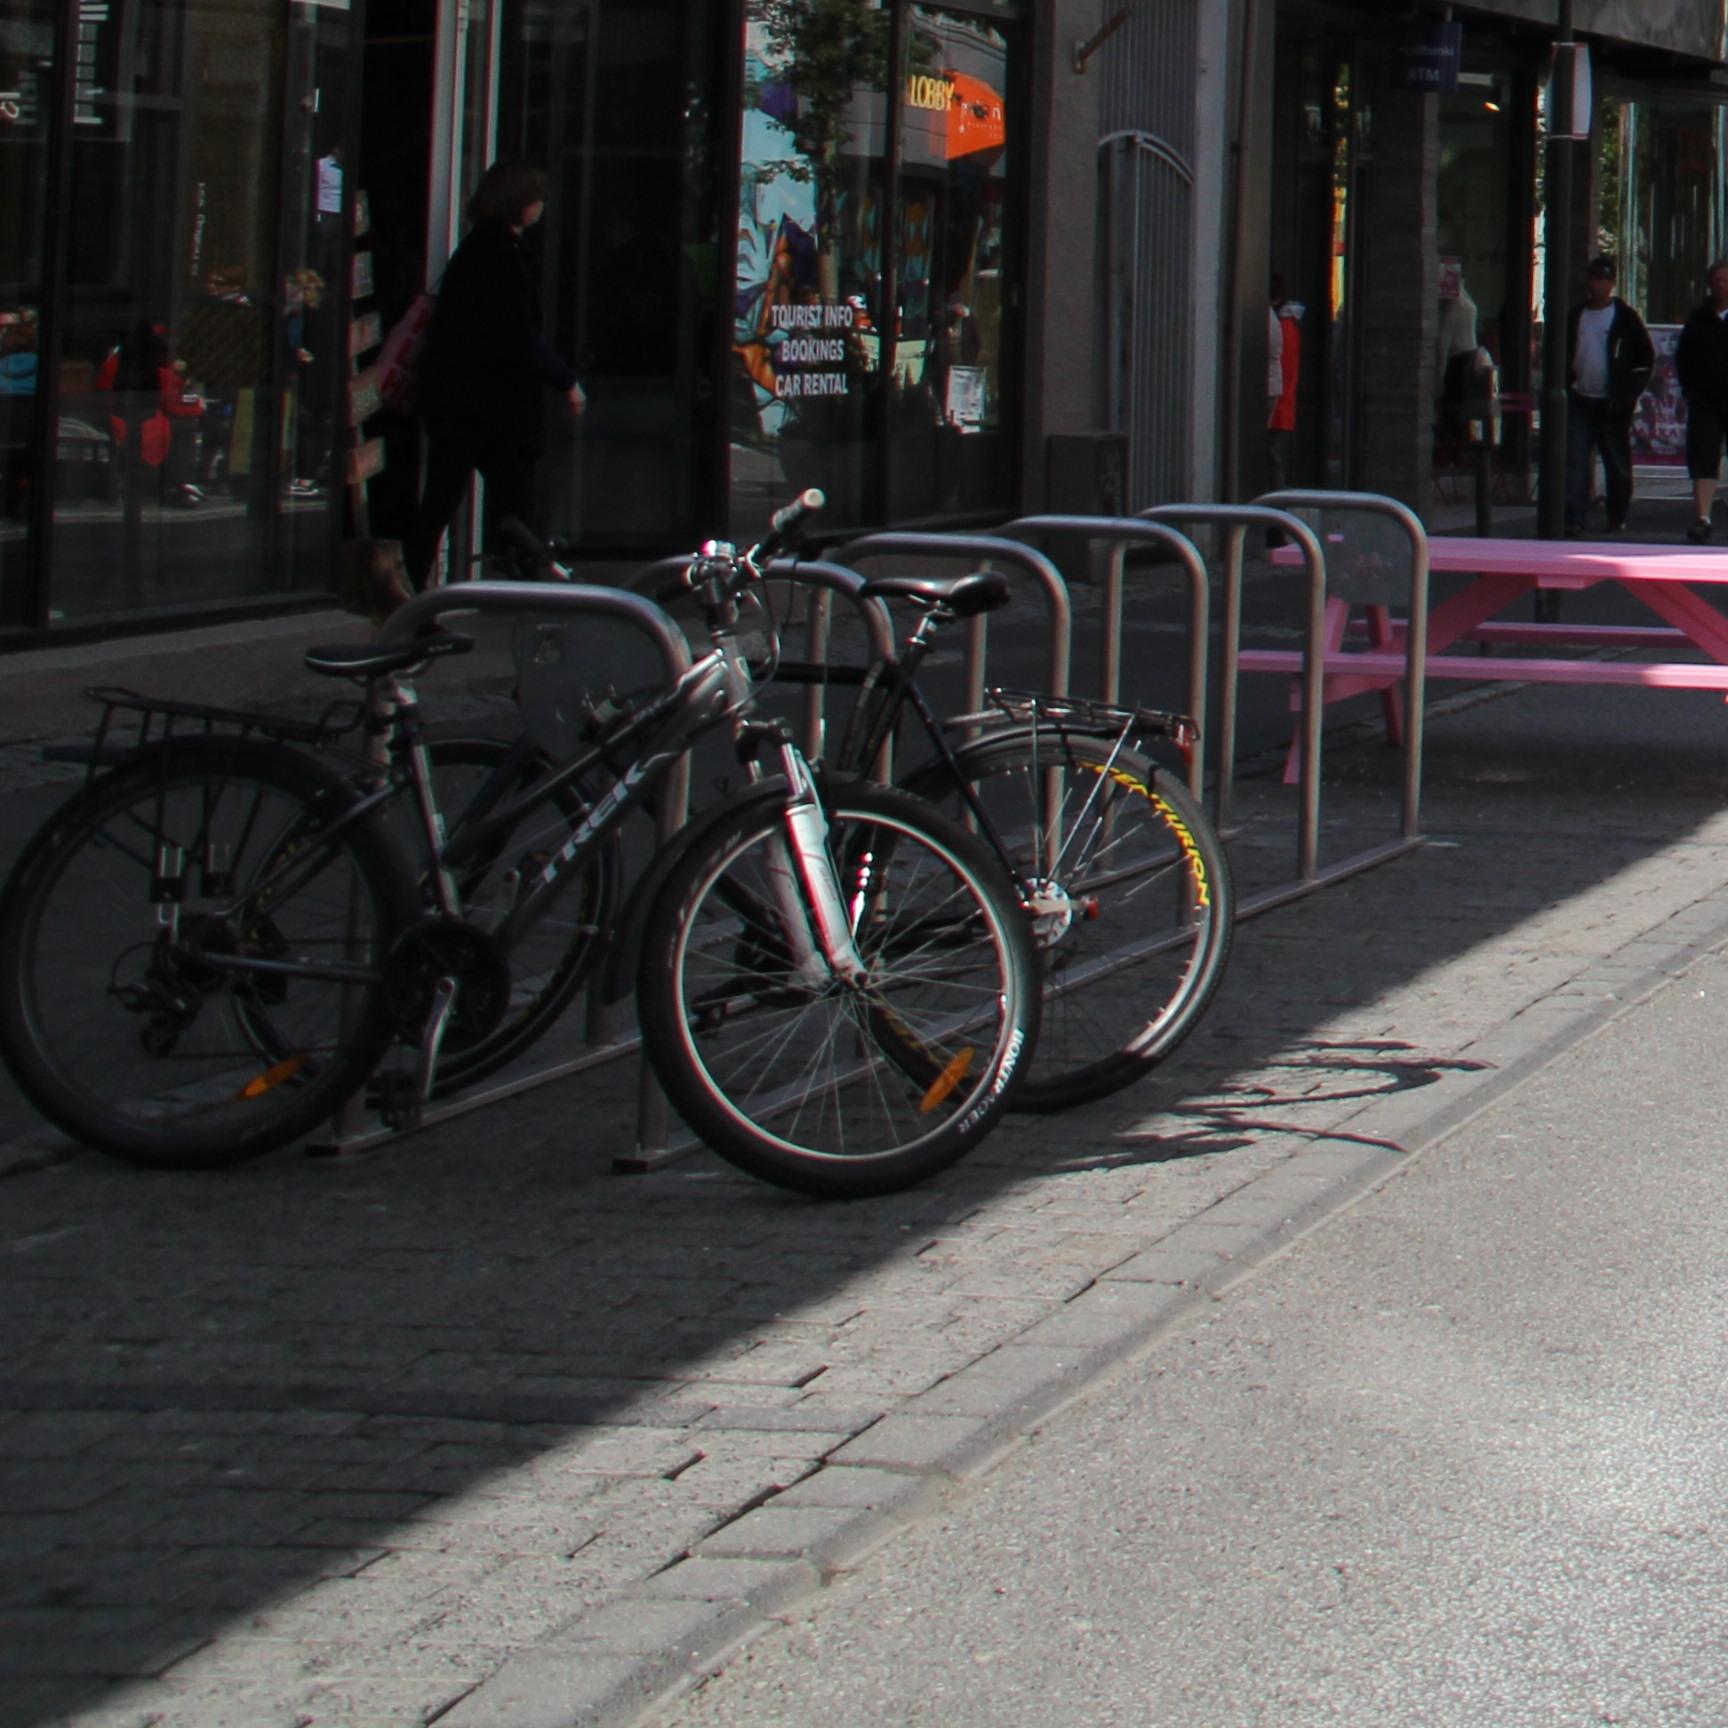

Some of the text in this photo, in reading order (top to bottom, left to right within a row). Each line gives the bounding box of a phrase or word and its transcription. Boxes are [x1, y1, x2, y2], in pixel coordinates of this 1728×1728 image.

[910, 74, 955, 112] LOBBY
[771, 304, 853, 327] TOURIST INFO
[781, 338, 845, 362] BOOKINGS
[774, 372, 848, 396] CAR RENTAL
[541, 758, 650, 885] TREK
